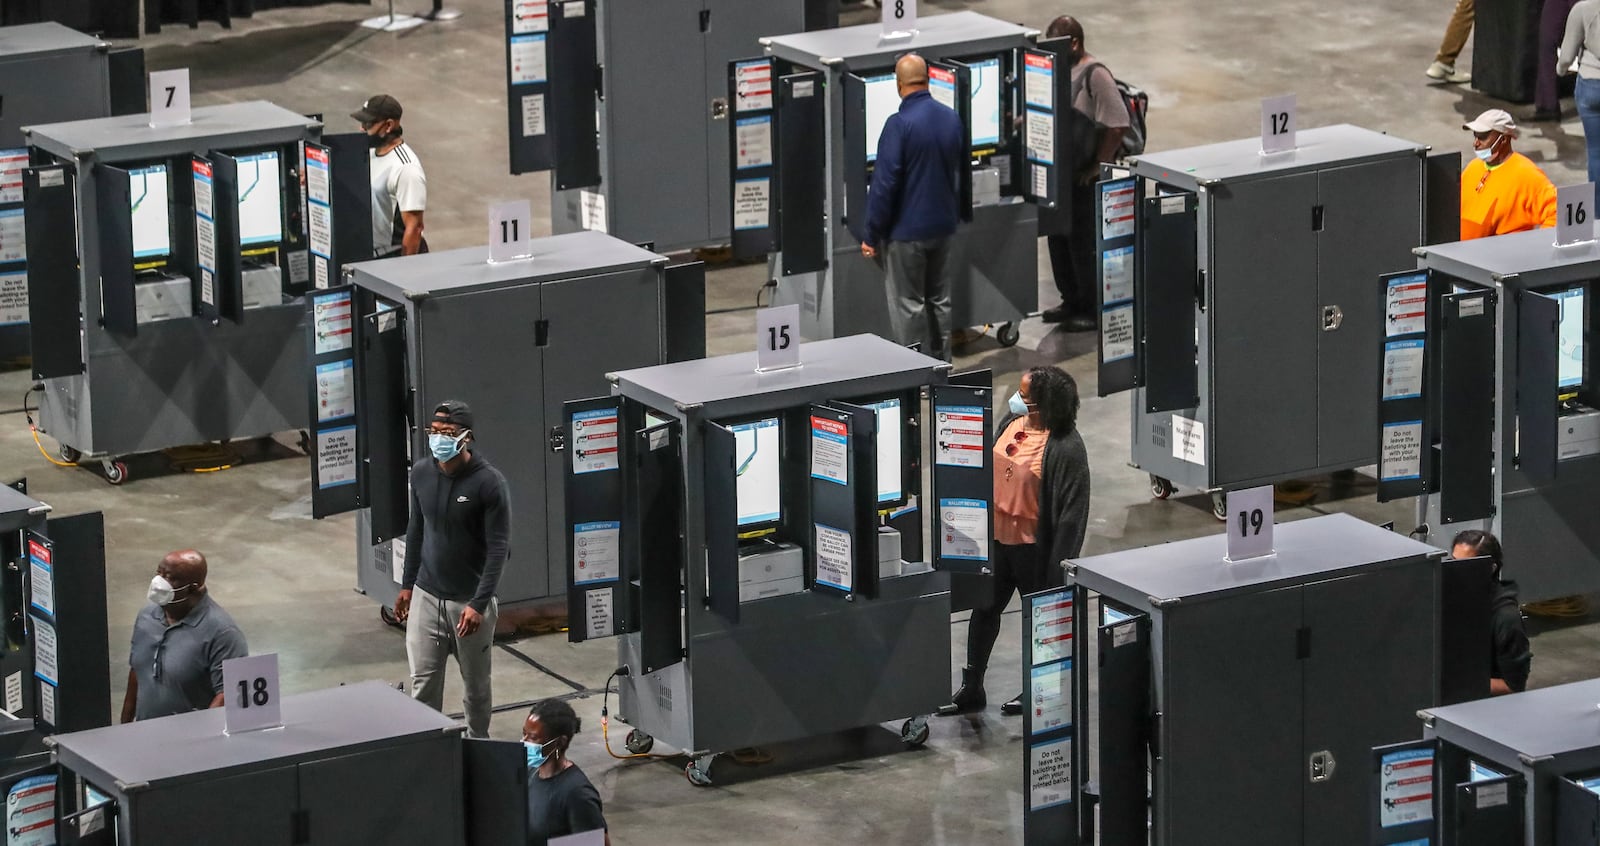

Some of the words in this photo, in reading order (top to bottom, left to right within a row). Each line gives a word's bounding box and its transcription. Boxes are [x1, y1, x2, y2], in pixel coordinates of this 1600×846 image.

[894, 0, 905, 19] 8
[165, 86, 176, 108] 7
[1271, 112, 1289, 136] 12
[1566, 202, 1586, 227] 16
[500, 218, 519, 244] 11
[768, 324, 791, 351] 15
[1239, 508, 1264, 538] 19
[237, 676, 269, 709] 18
[1038, 758, 1053, 767] leave
[1051, 749, 1060, 757] not
[1032, 764, 1056, 776] balloting
[1057, 762, 1070, 770] area
[1038, 773, 1050, 781] with
[1051, 770, 1064, 779] your
[1032, 780, 1052, 791] printed
[1052, 776, 1070, 785] ballot.
